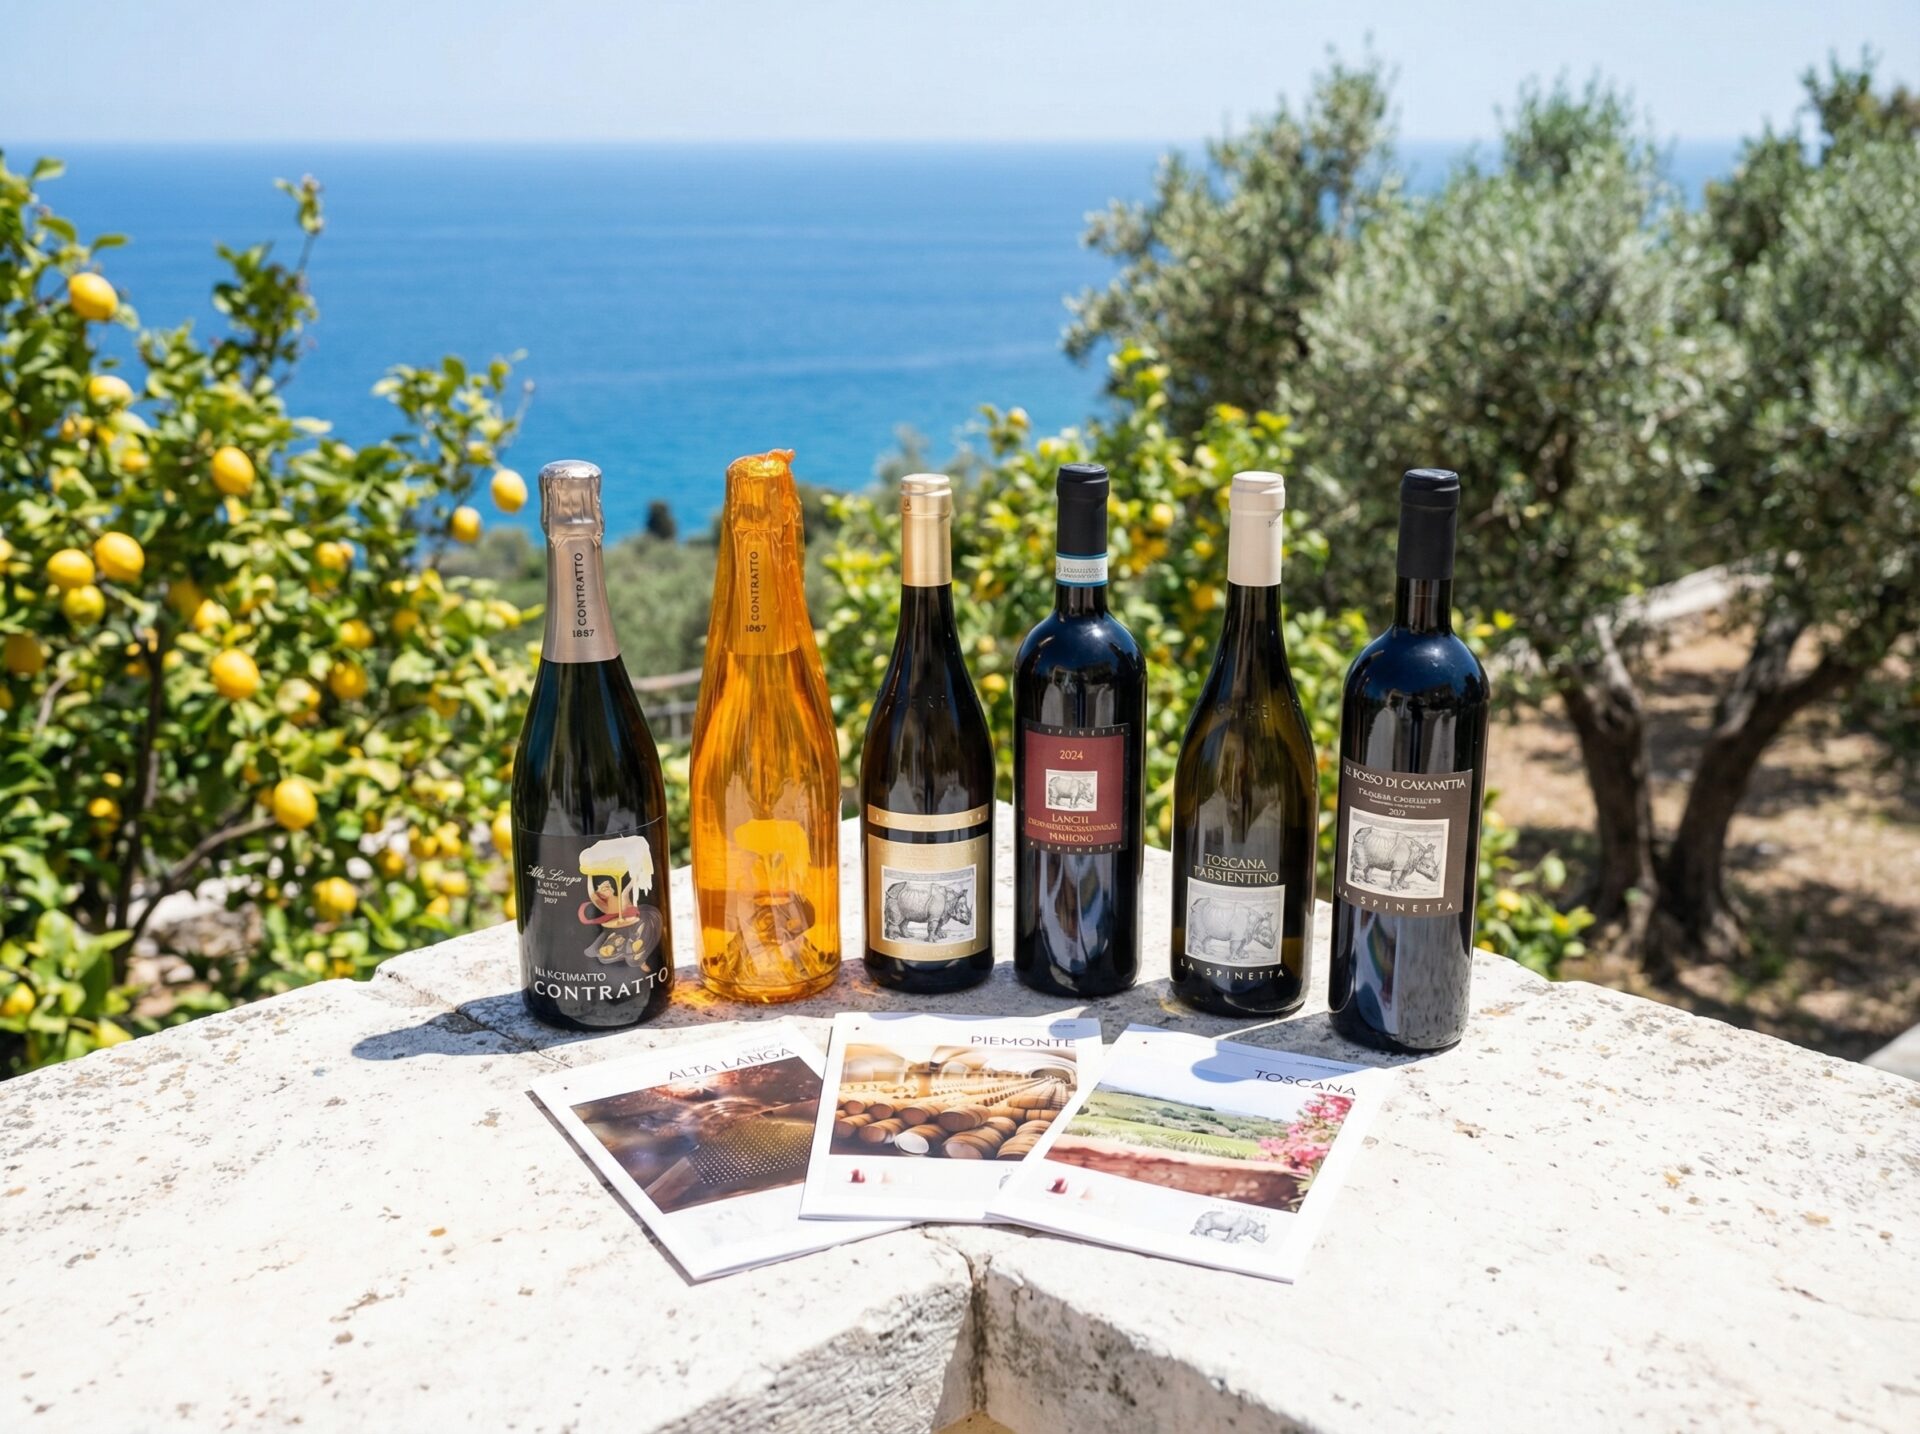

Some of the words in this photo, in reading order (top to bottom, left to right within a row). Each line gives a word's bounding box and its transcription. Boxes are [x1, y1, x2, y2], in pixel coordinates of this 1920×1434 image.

[574, 552, 587, 626] CONTRATTO
[749, 551, 760, 621] CONTRATTO
[1059, 750, 1084, 760] 2024
[1385, 777, 1398, 788] DI
[1205, 853, 1267, 869] TOSCANA
[1360, 896, 1453, 913] SPINETTA
[1180, 958, 1194, 971] LA
[1206, 968, 1285, 981] SPINETTA
[534, 966, 669, 1001] CONTRATTO
[971, 1035, 1076, 1048] PIEMONTE
[669, 1064, 718, 1080] ALTA
[721, 1047, 795, 1069] LANGA
[1255, 1069, 1356, 1096] TOSCANA
